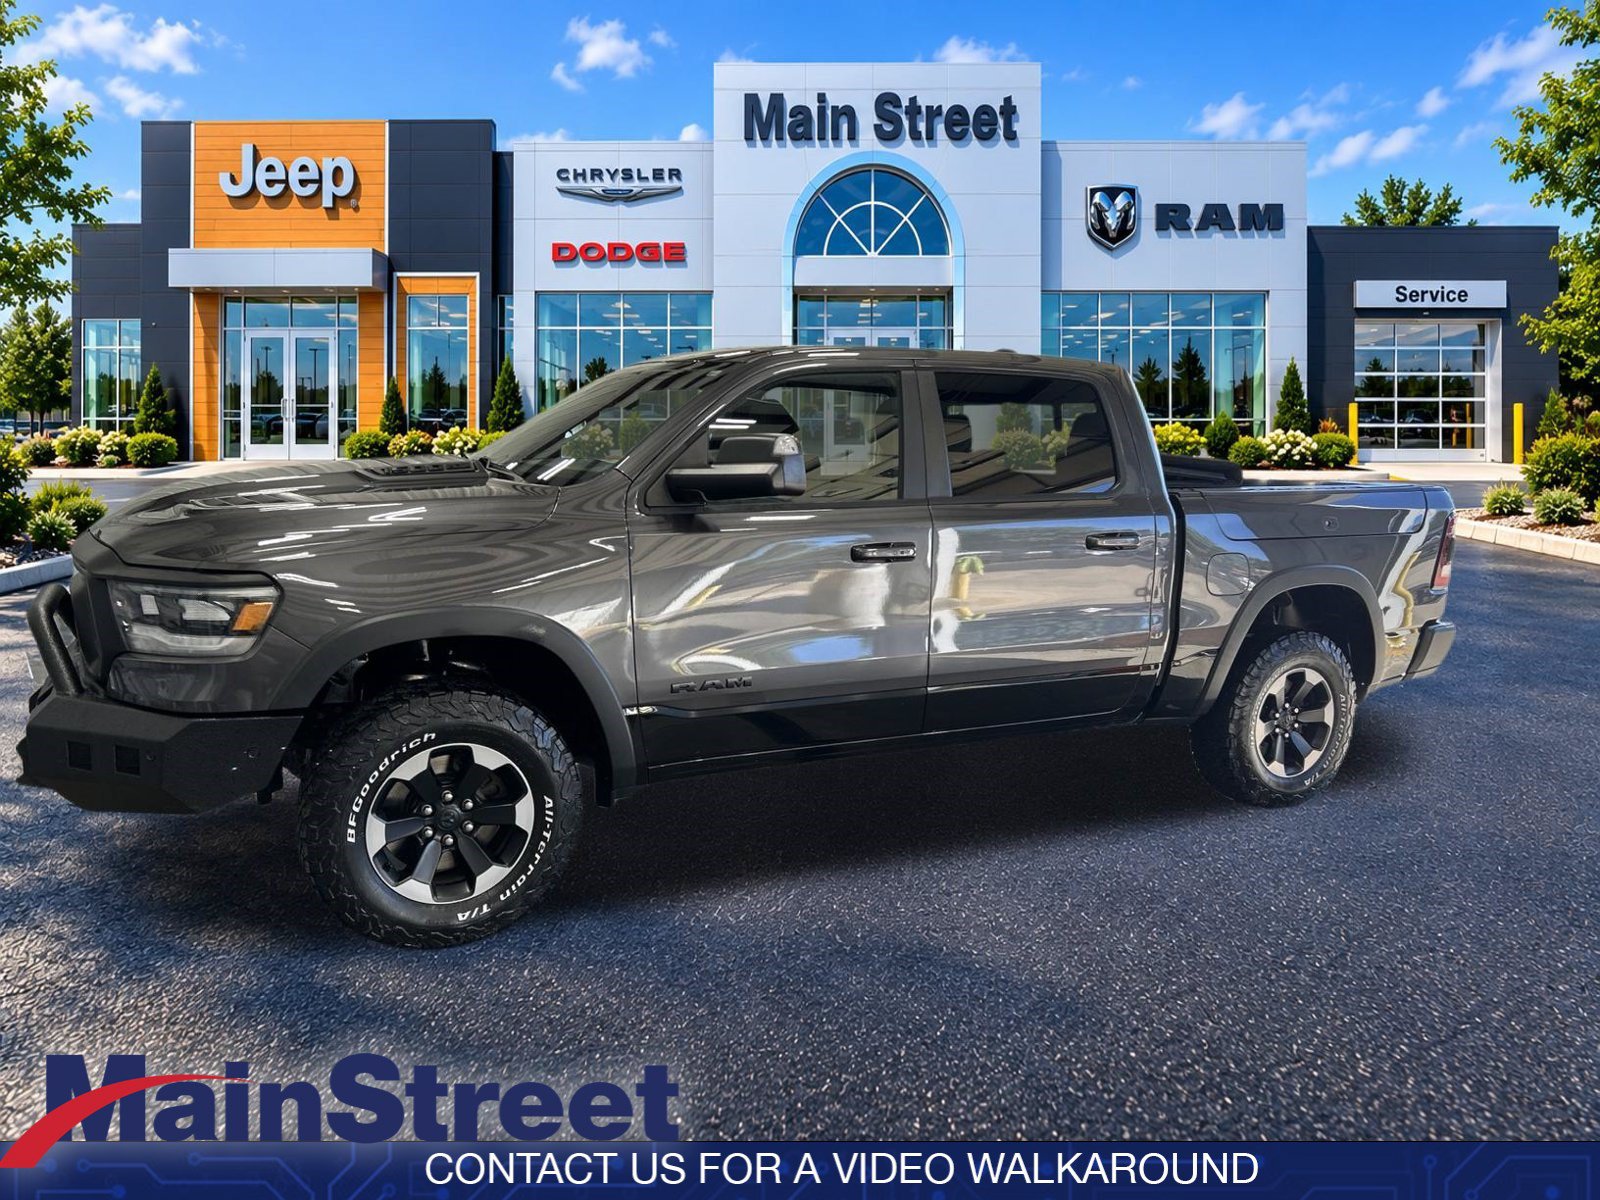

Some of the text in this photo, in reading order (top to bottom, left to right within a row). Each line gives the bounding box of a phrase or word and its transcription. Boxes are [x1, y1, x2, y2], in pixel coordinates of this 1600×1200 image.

[744, 92, 1018, 141] Main Street
[219, 143, 355, 208] Jeep
[556, 168, 683, 182] CHRYSLER
[1155, 203, 1284, 232] RAM
[551, 242, 686, 263] DODGE
[1395, 285, 1469, 304] Service
[670, 676, 753, 694] RAM
[346, 731, 555, 921] BFGoodrich All-Terrain T/A
